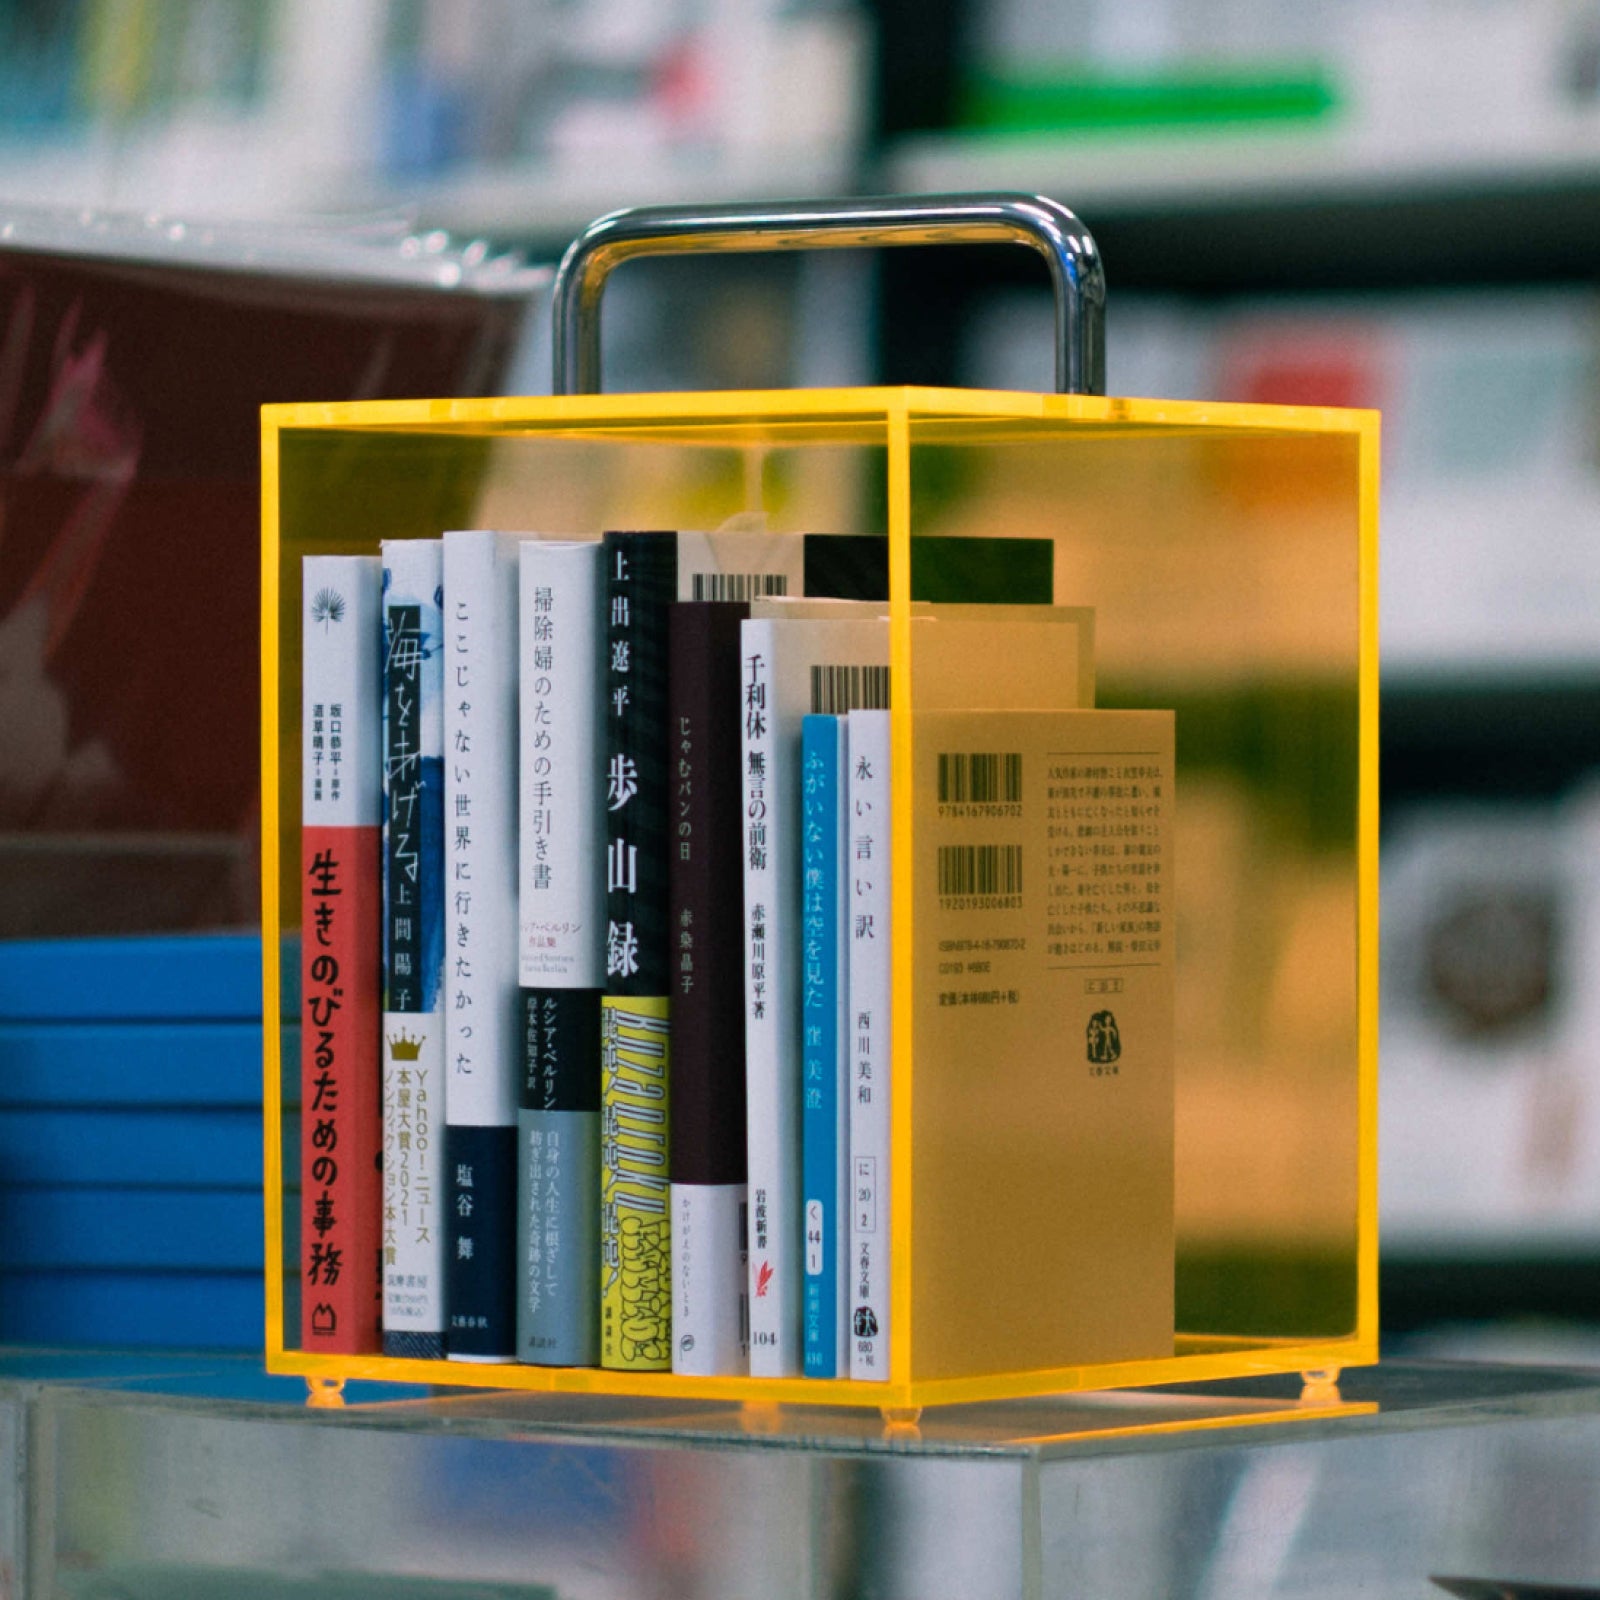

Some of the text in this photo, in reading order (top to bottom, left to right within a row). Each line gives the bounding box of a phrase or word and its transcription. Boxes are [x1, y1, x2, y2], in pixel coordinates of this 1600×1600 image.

[532, 586, 553, 890] 掃除婦のための手引き書
[678, 716, 693, 861] じゃむパンの日
[745, 655, 767, 871] 千利休 無言の前衛
[454, 602, 472, 1074] ここじゃない世界に行きたかった
[607, 753, 639, 977] 歩山録
[805, 752, 824, 1008] ふがいない僕は空を見た
[855, 756, 875, 940] 永い言い訳
[394, 884, 413, 1011] 上間陽子
[680, 909, 694, 994] 赤染晶子
[307, 848, 344, 1287] 生きのびるための事務
[542, 997, 558, 1109] ルシア・ベルリン
[857, 1011, 873, 1104] 西川美和
[396, 1068, 412, 1226] 本屋大賞2021
[414, 1068, 431, 1244] Yahoo!ニュース
[755, 1189, 768, 1249] 岩波新書
[808, 1231, 821, 1244] 44
[860, 1242, 870, 1298] 文春文庫
[861, 1213, 868, 1227] 2
[752, 1332, 777, 1347] 104
